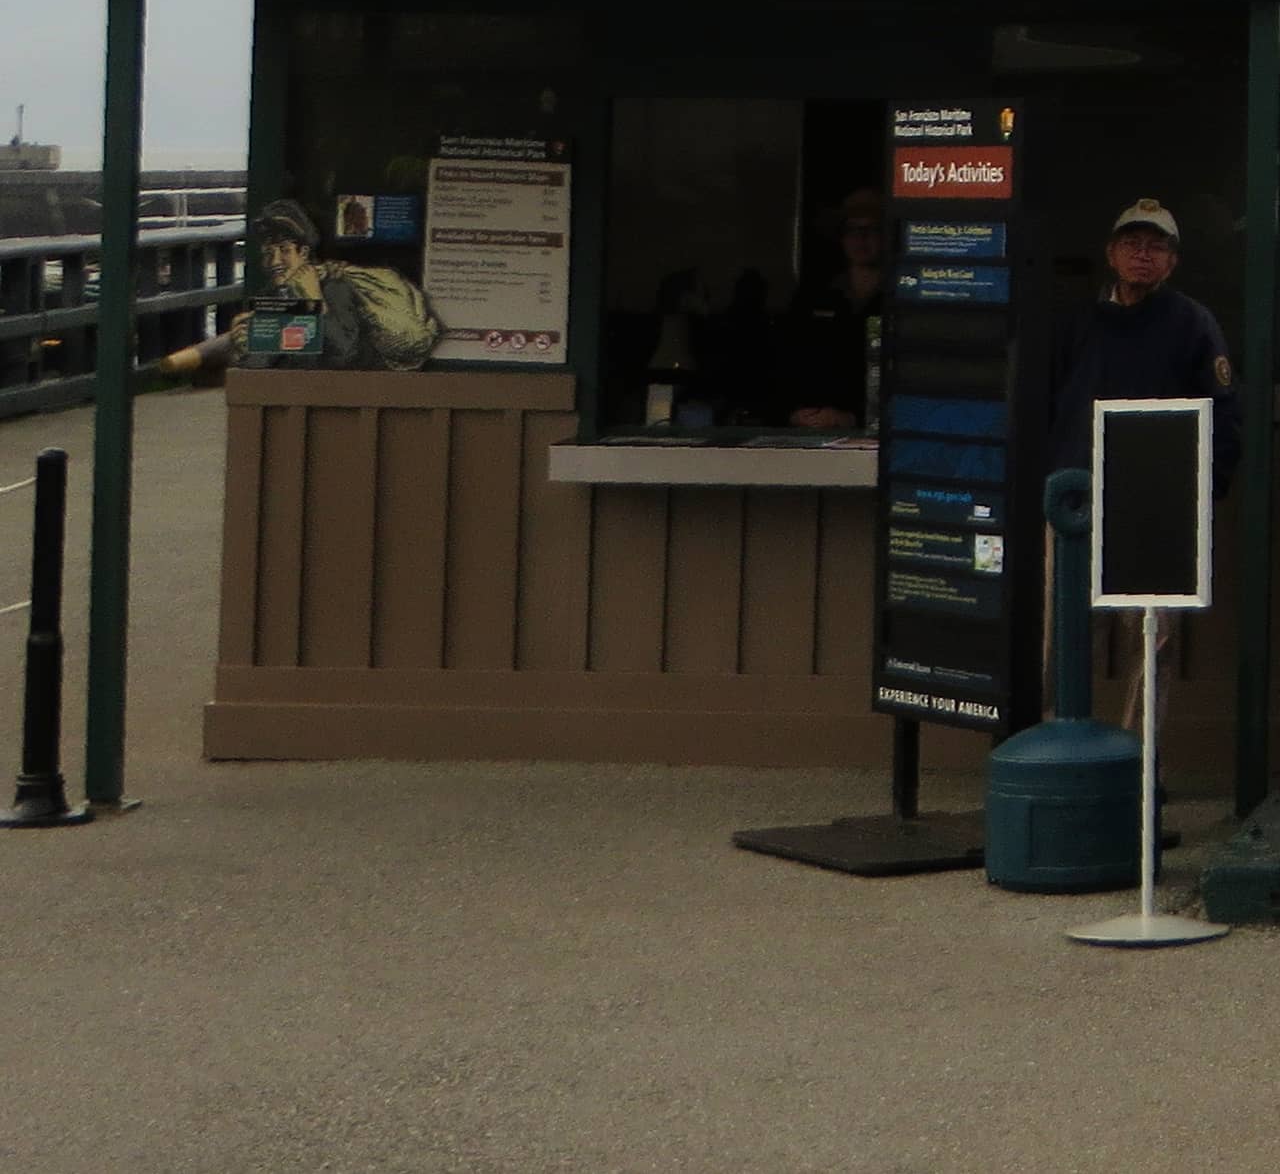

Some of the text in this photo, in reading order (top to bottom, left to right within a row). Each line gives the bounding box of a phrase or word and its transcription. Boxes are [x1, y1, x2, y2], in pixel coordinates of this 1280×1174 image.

[902, 161, 1004, 188] Today's Activities
[879, 686, 1000, 720] EXPERIENCE YOUR AMERICA
